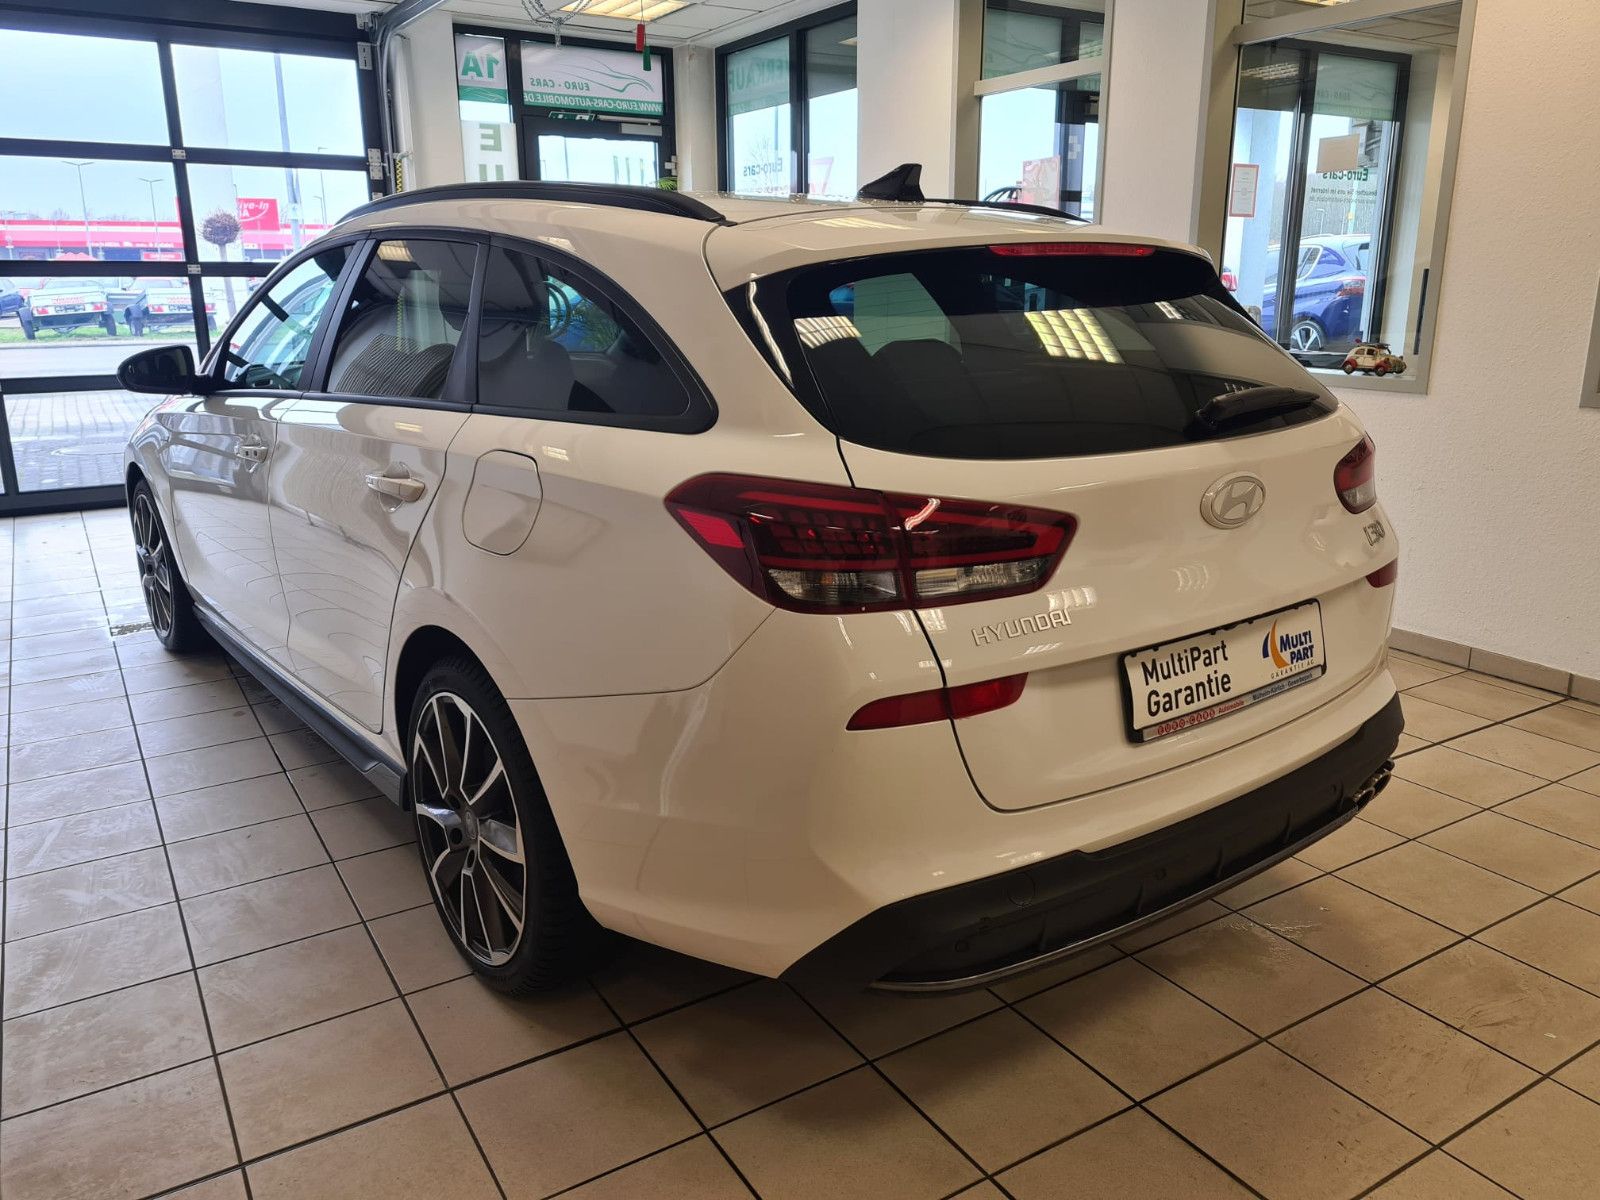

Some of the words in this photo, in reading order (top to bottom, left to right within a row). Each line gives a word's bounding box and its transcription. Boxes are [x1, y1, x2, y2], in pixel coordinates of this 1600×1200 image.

[972, 606, 1073, 648] HYUNDAI
[1279, 630, 1313, 653] MULTI
[1140, 640, 1229, 686] MultiPart
[1270, 663, 1304, 679] GARANTIE
[1290, 645, 1315, 665] PART
[1146, 671, 1232, 718] Garantie
